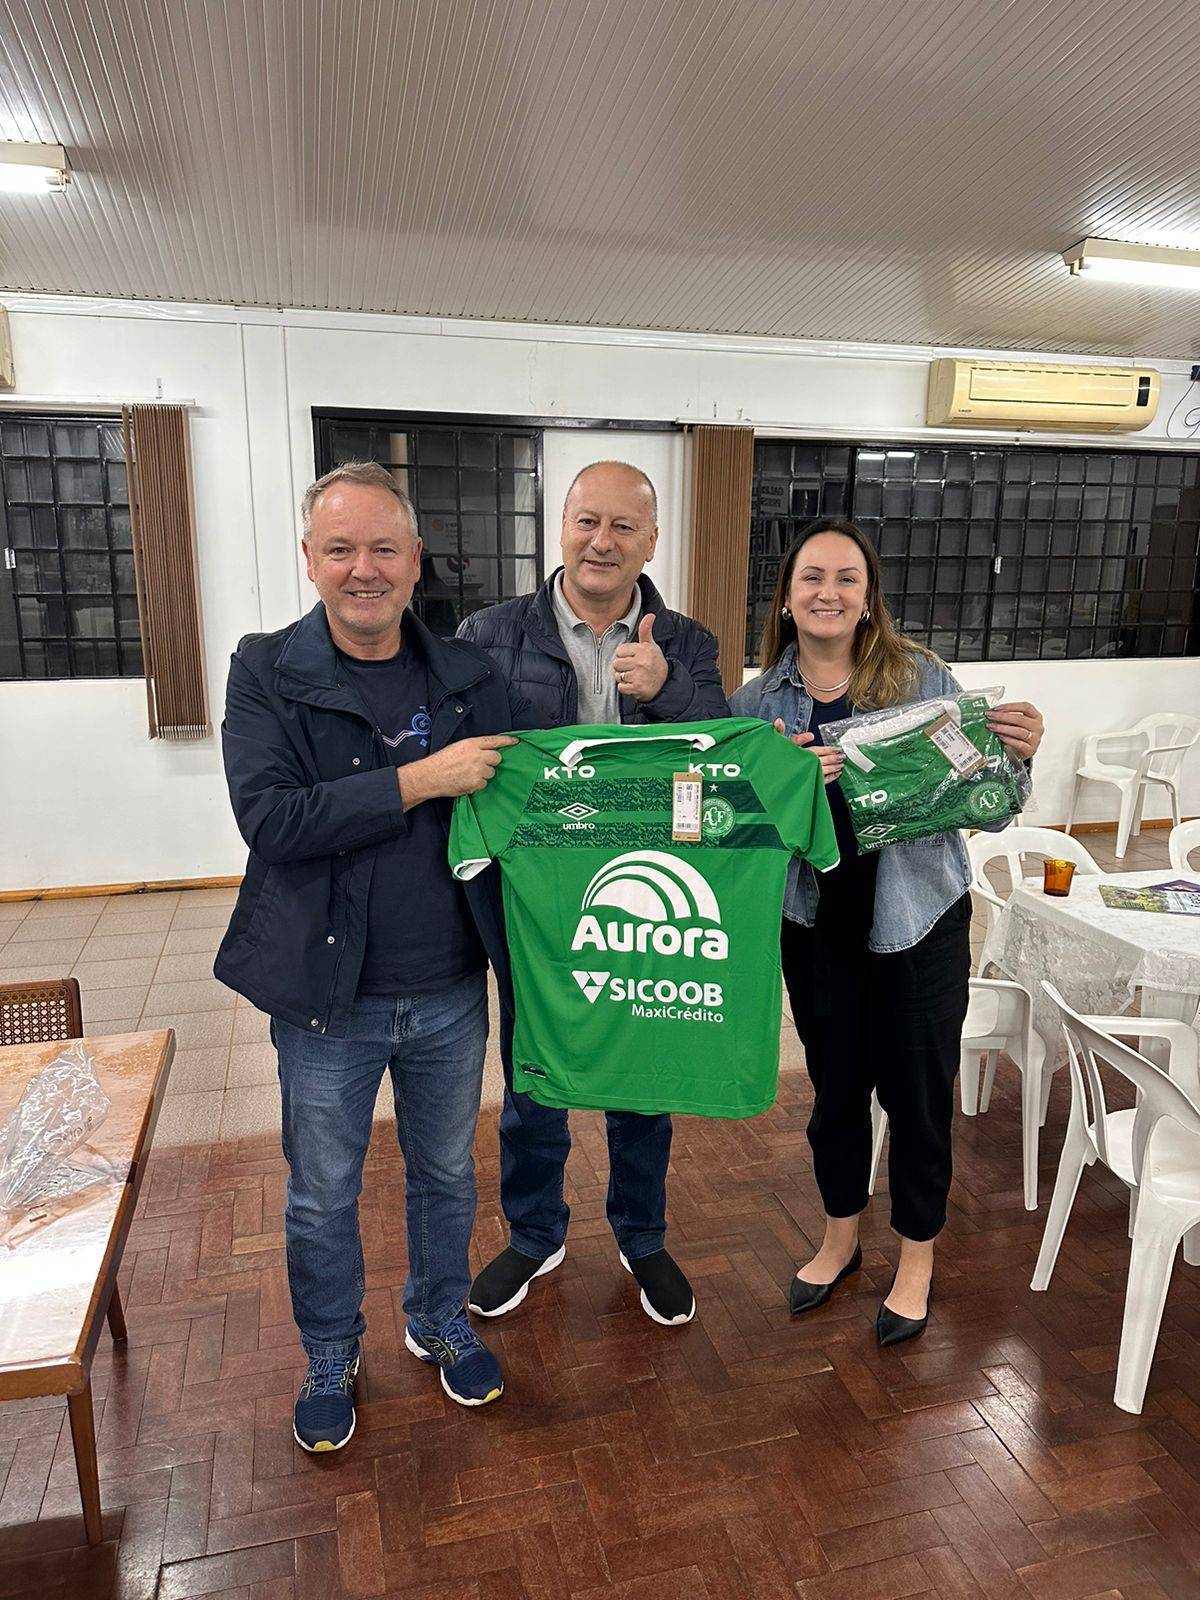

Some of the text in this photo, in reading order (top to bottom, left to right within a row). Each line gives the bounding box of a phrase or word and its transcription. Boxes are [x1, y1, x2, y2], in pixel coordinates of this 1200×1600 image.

[543, 765, 596, 779] KTO
[688, 763, 741, 777] KTO
[562, 821, 596, 831] umbro
[570, 914, 730, 961] Aurora
[609, 977, 724, 1008] SICOOB
[631, 1003, 725, 1024] MaxiCrédito
